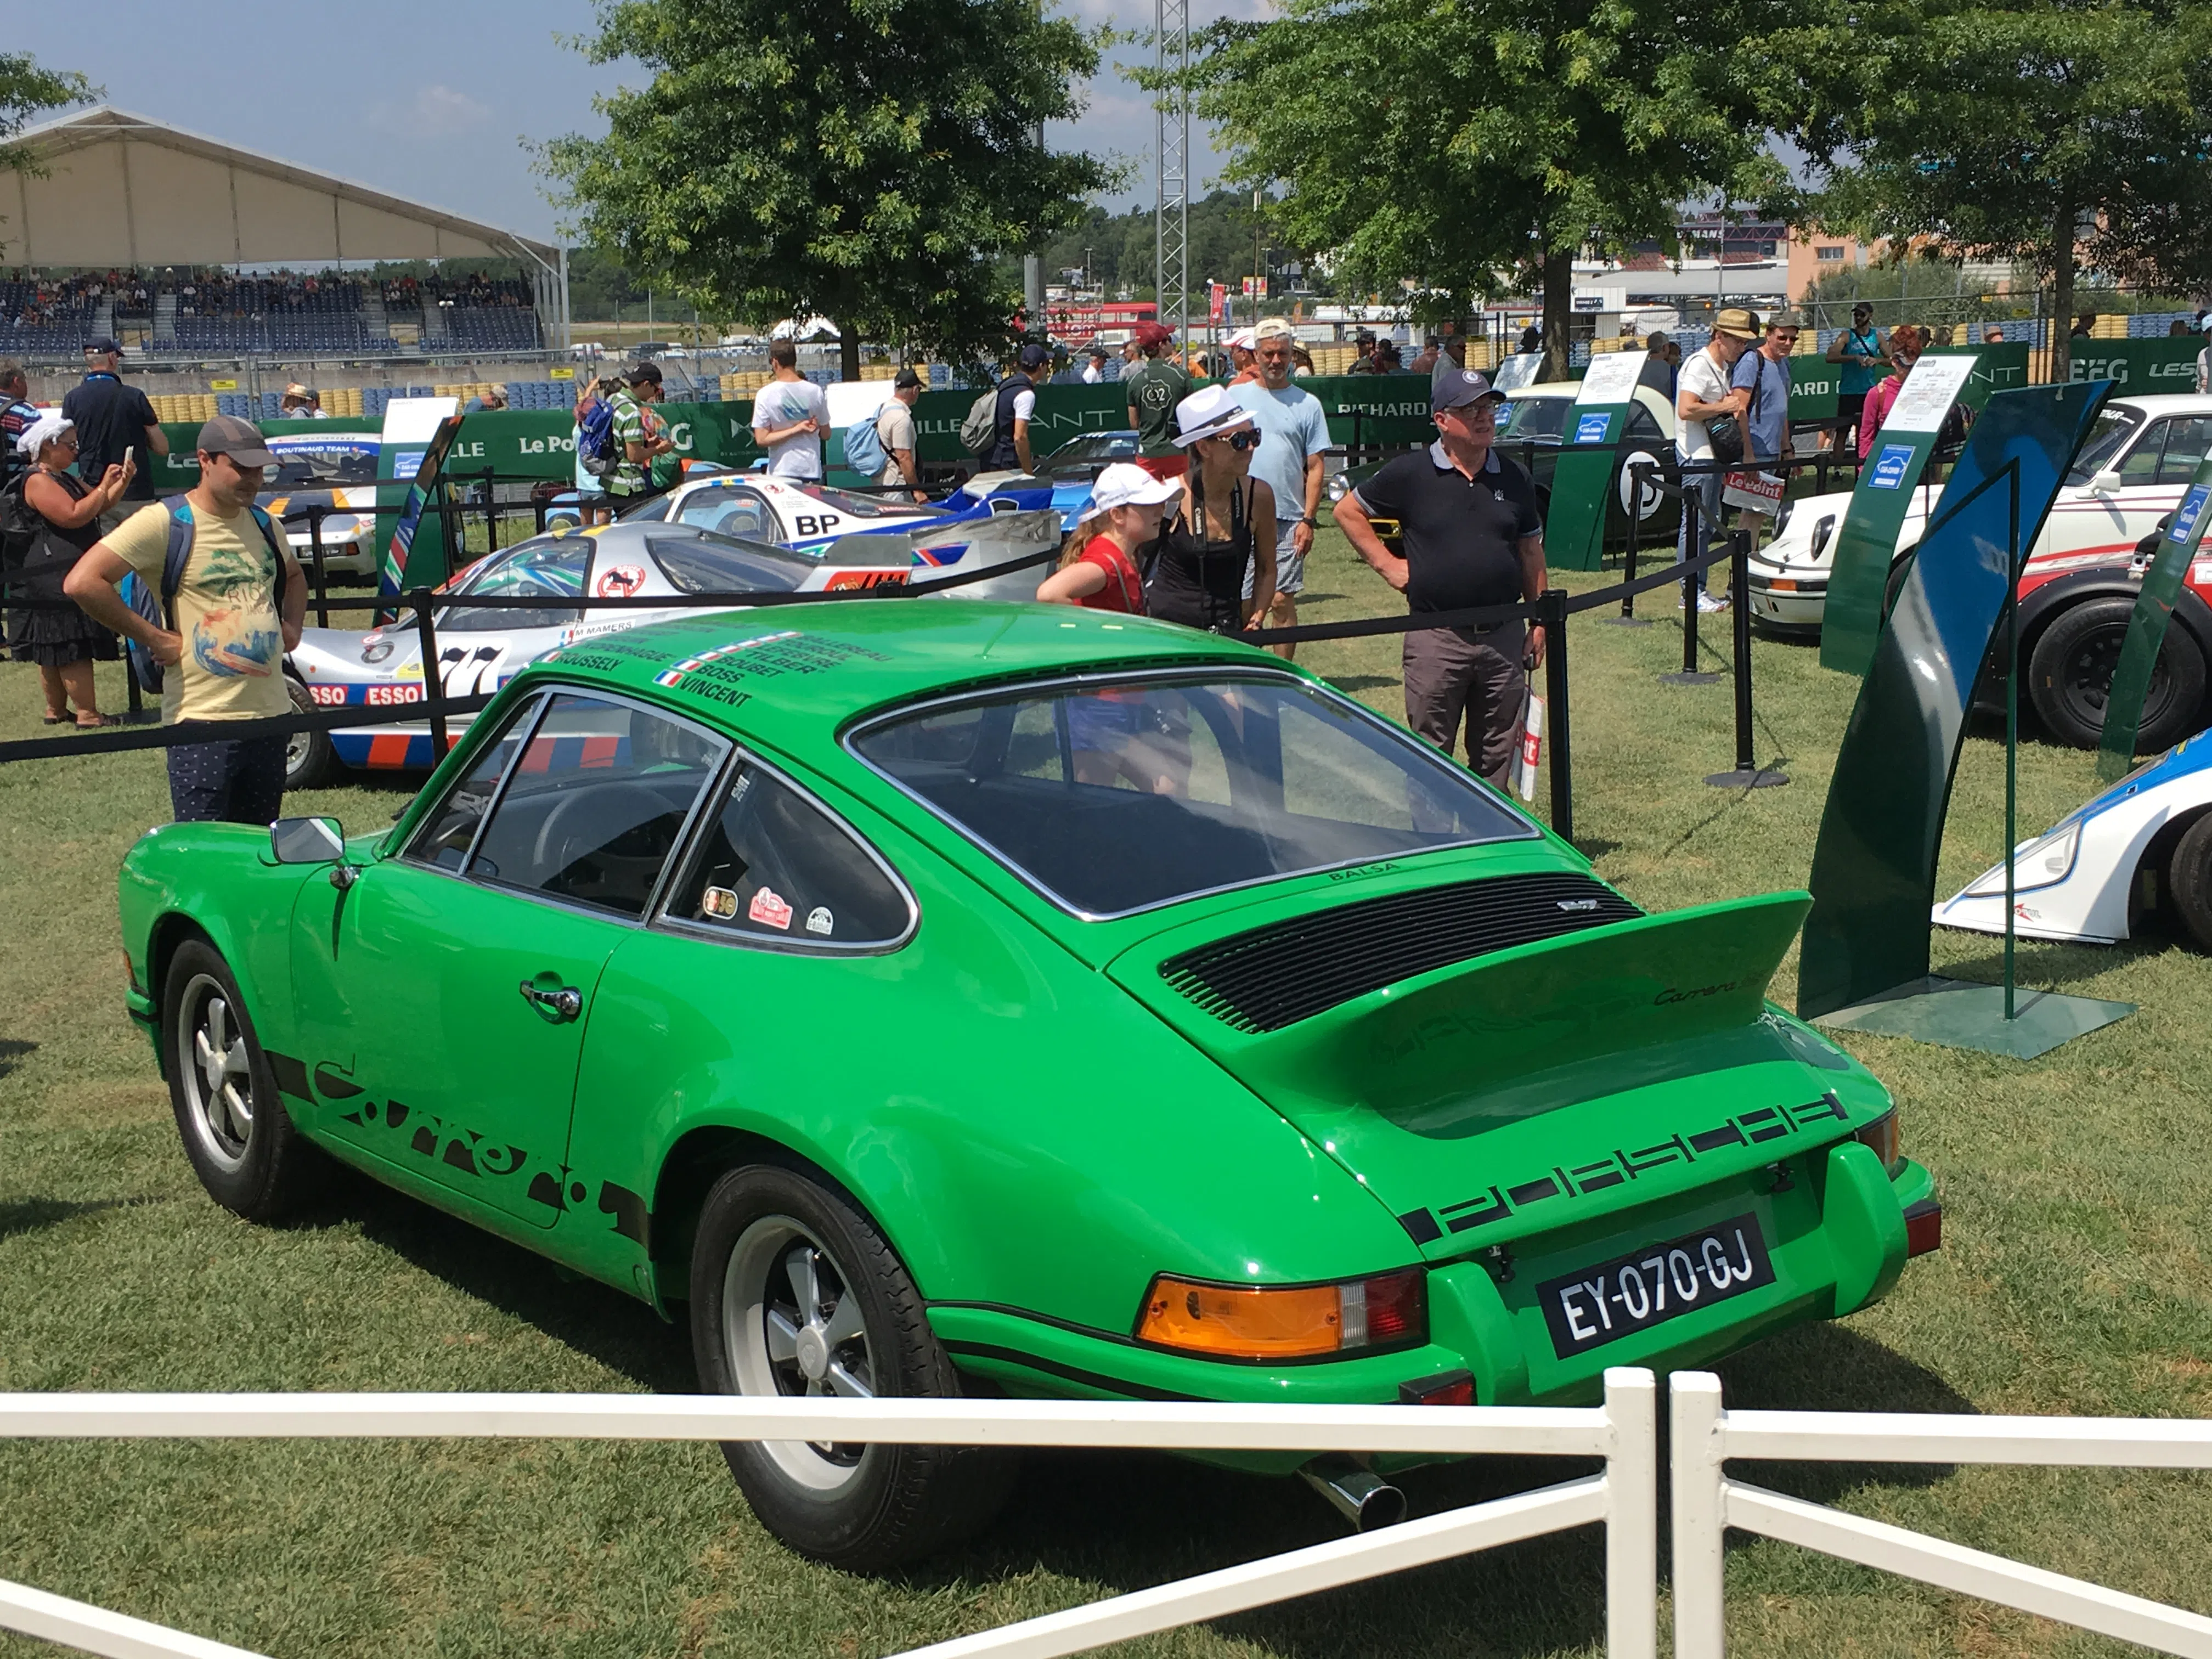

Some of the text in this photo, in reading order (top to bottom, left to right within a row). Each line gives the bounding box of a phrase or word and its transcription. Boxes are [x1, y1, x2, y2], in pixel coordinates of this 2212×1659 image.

[276, 446, 324, 454] BOUTINAUD
[519, 438, 544, 454] Le
[1729, 474, 1743, 487] Le
[795, 514, 840, 537] BP
[227, 586, 262, 603] RIO
[586, 620, 633, 635] MAMERS
[696, 665, 746, 684] BOSS
[716, 656, 786, 678] BOUBET
[309, 687, 346, 705] SSO
[369, 687, 418, 705] ESSO
[679, 676, 753, 708] VINCENT
[1328, 862, 1401, 882] BALSA
[2014, 907, 2042, 919] OTUL
[299, 1051, 625, 1234] Carrera
[1559, 1228, 1753, 1342] EY-070-GJ
